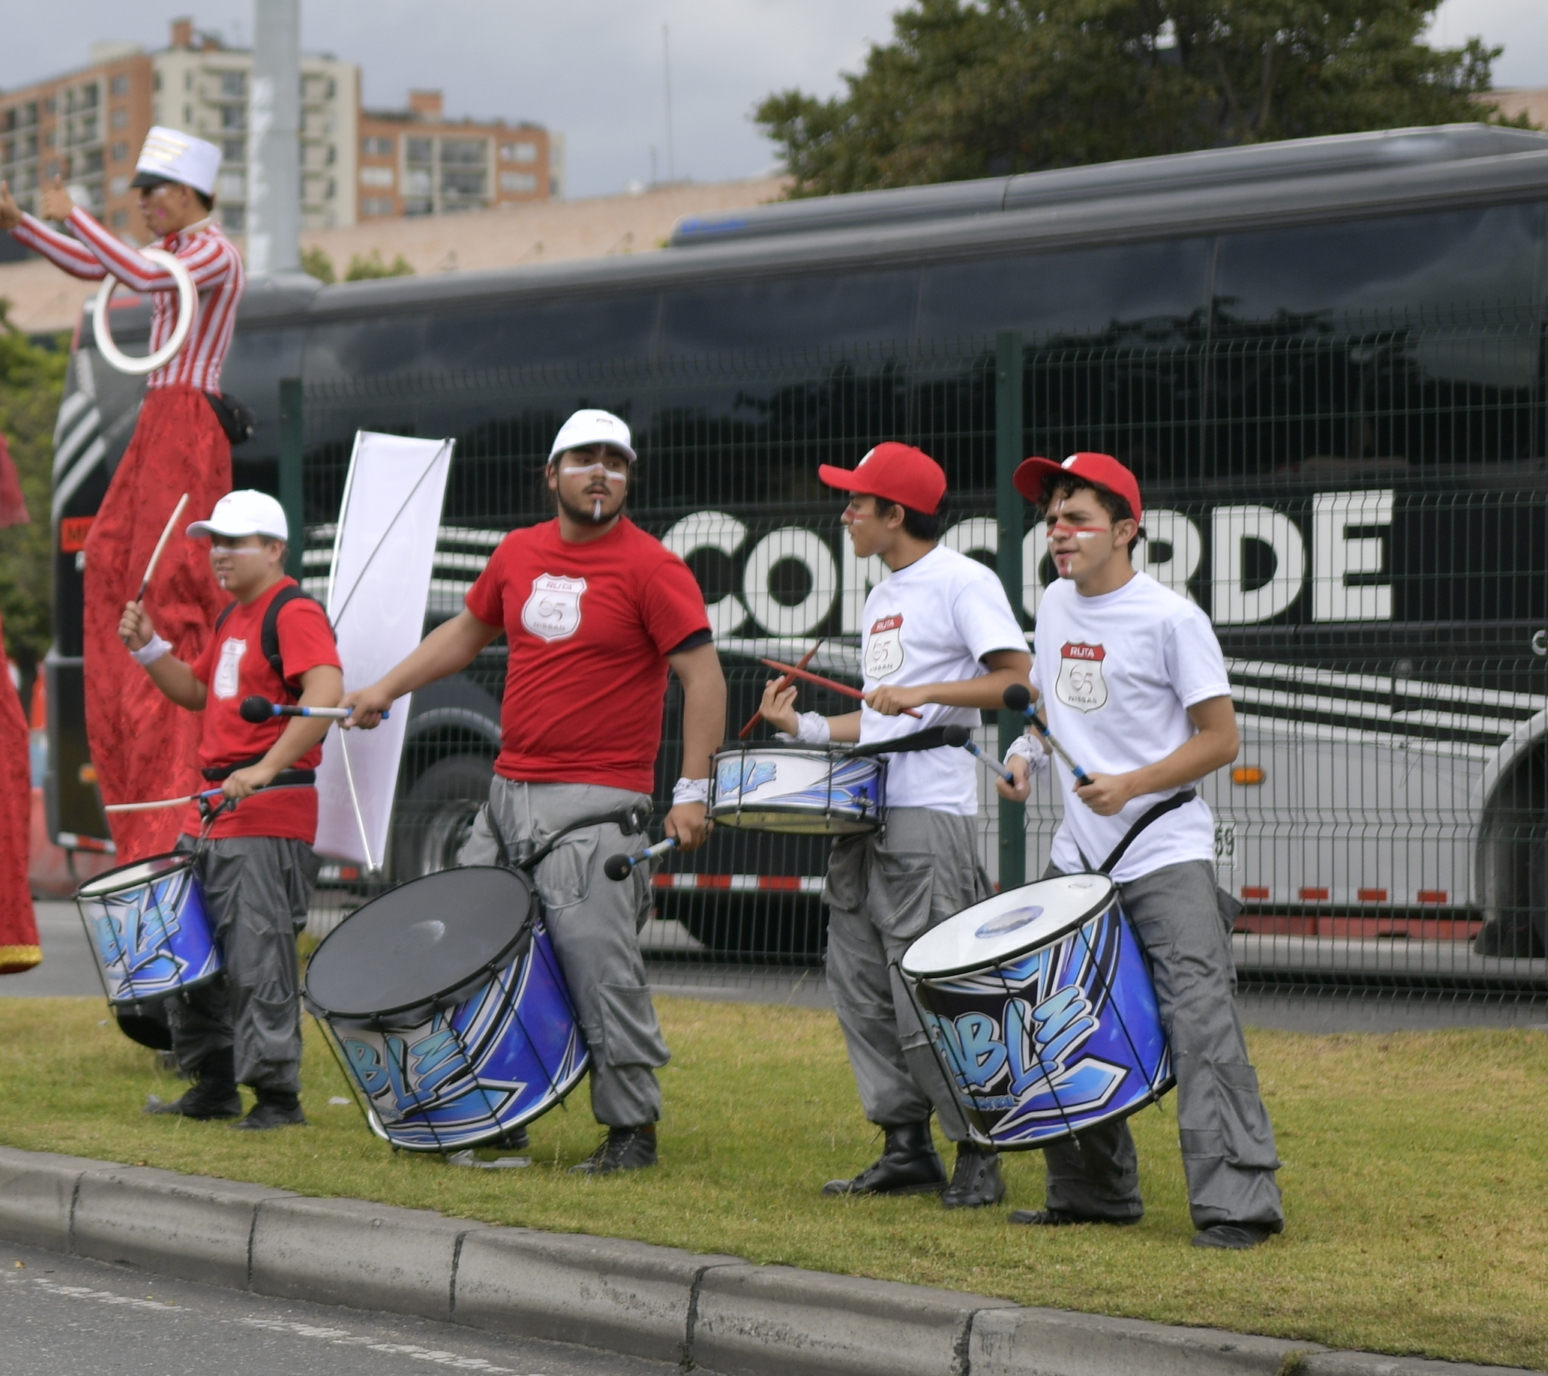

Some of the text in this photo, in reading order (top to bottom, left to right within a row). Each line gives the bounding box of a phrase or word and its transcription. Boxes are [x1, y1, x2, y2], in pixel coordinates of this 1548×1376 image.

[546, 581, 573, 591] RUTA
[1070, 646, 1095, 658] RUTA
[1068, 695, 1098, 704] NISSAN
